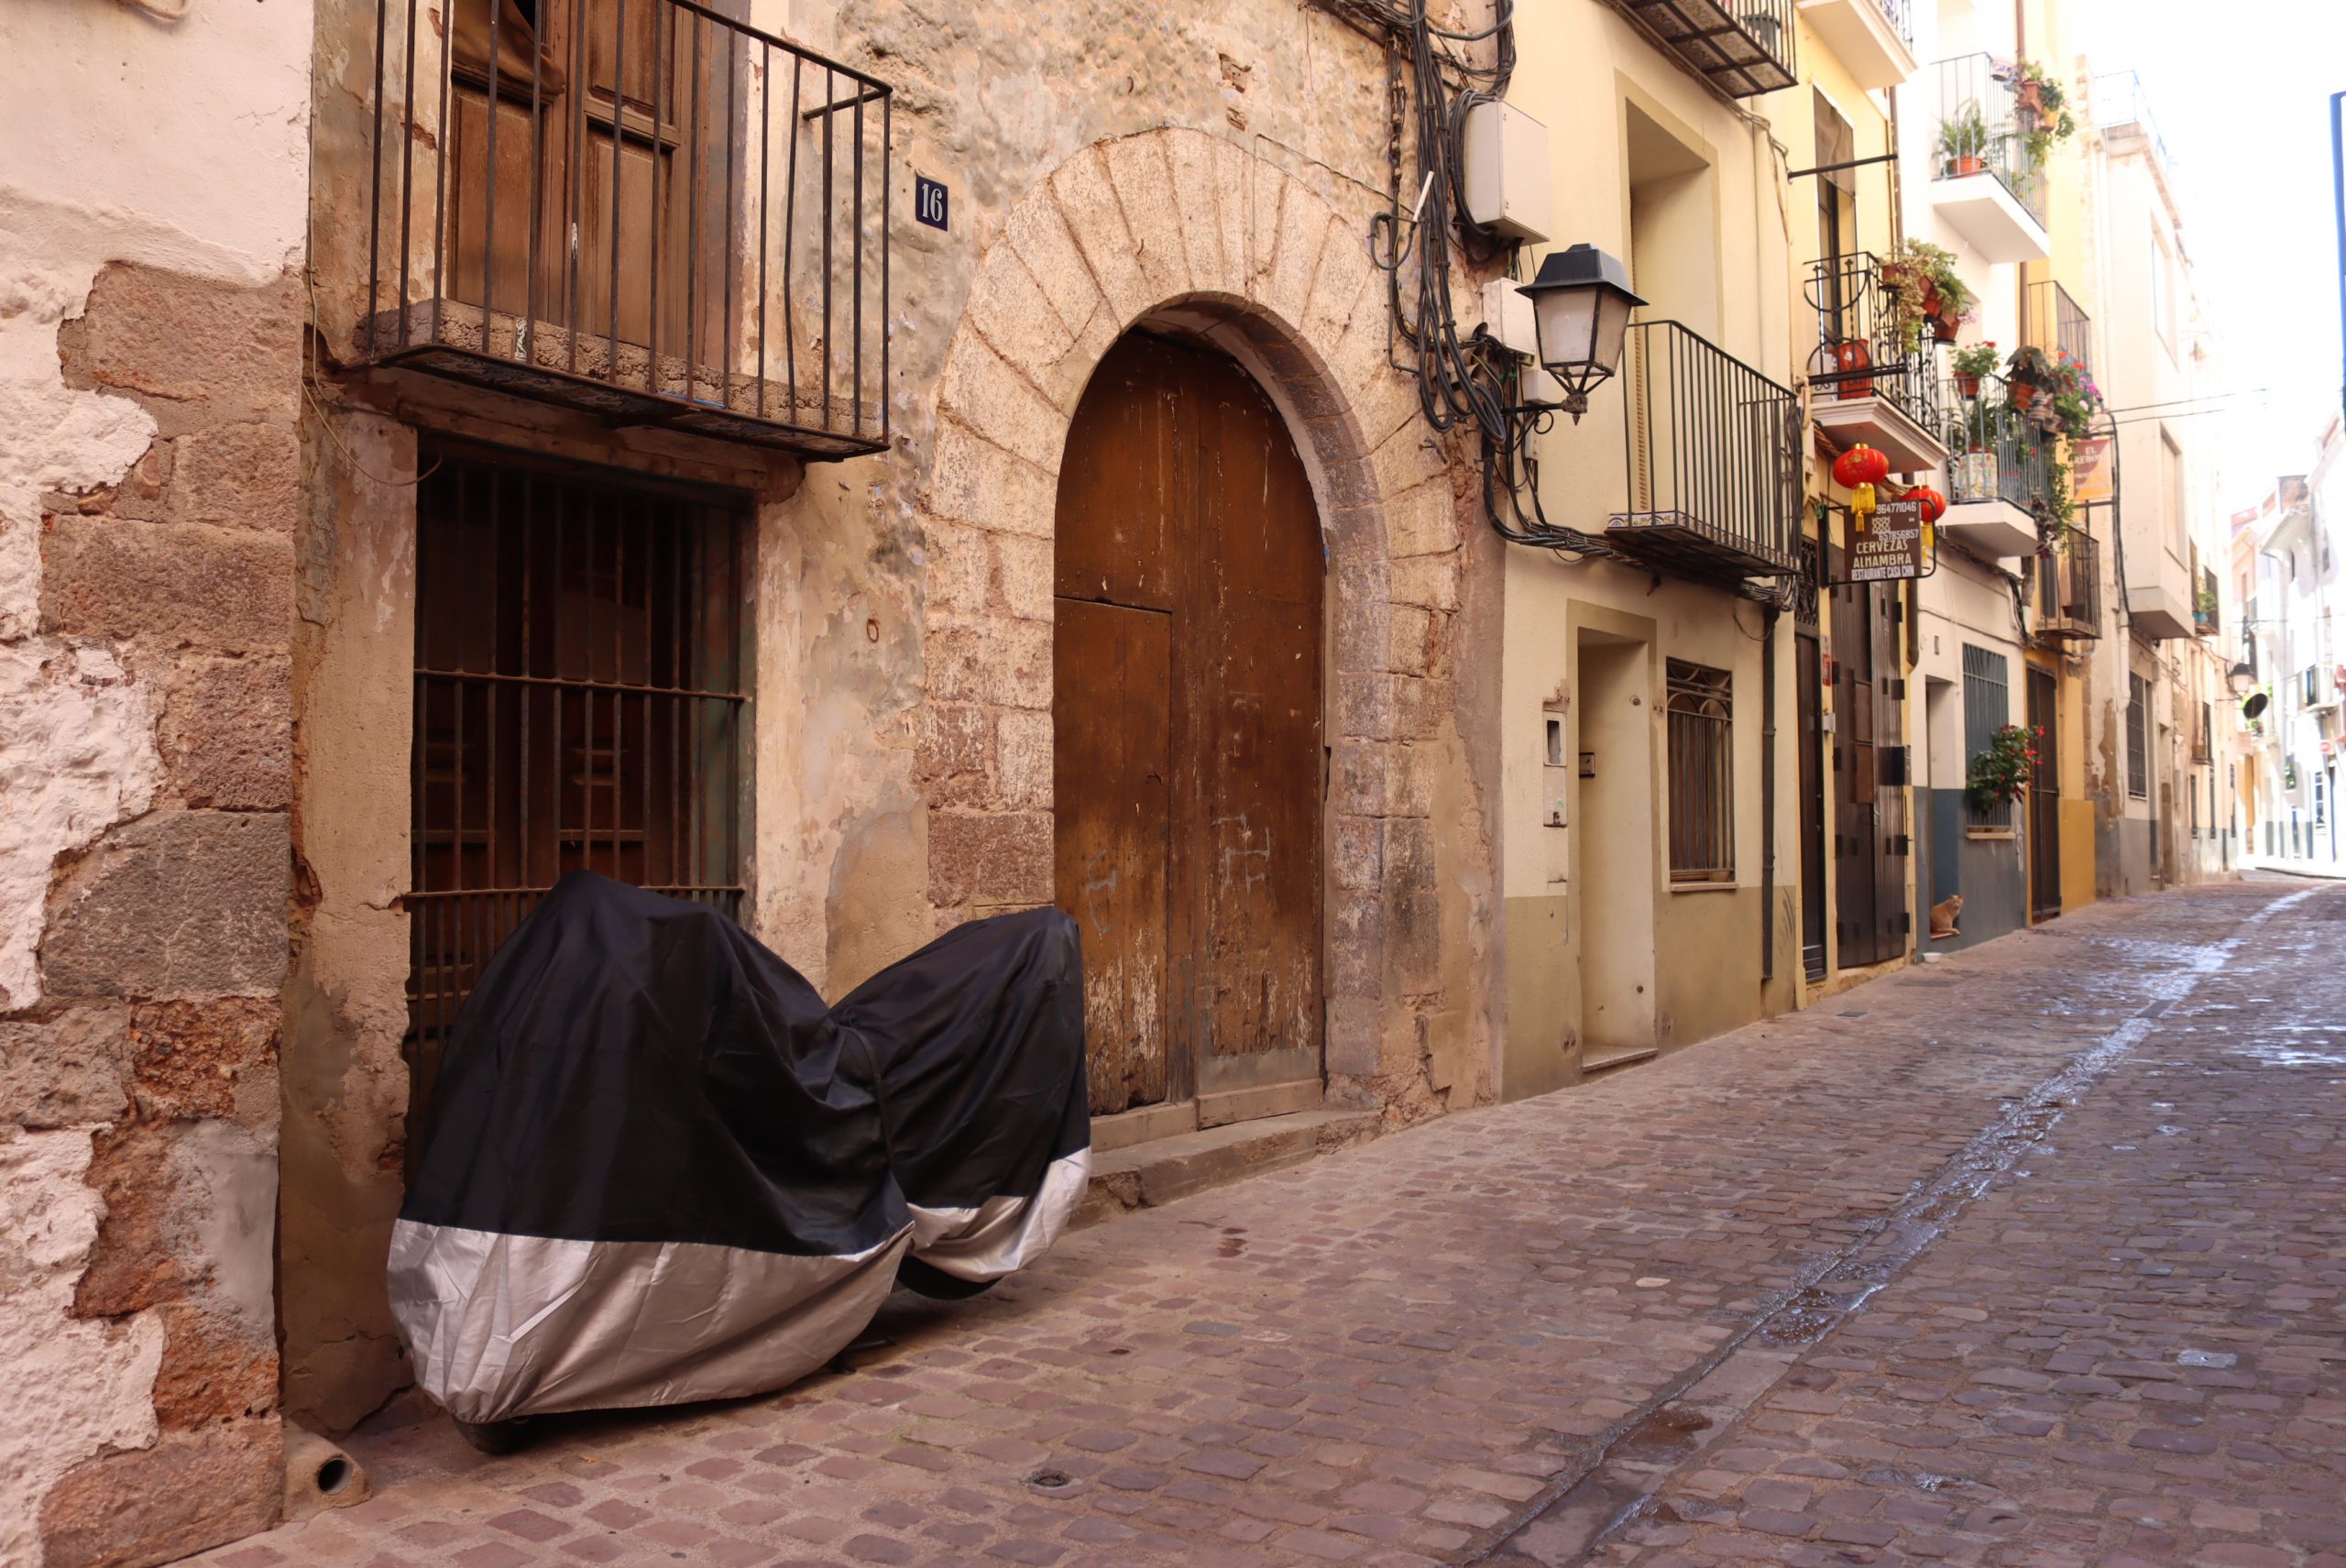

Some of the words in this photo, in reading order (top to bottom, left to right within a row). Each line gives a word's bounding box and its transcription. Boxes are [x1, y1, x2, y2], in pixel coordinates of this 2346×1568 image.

[921, 182, 943, 222] 16
[1876, 502, 1917, 515] 964771046
[1856, 539, 1908, 554] CERVEZAS
[1853, 553, 1912, 568] ALHAMBRA
[1851, 566, 1886, 581] RESTAURANTE
[1887, 565, 1901, 579] CASA
